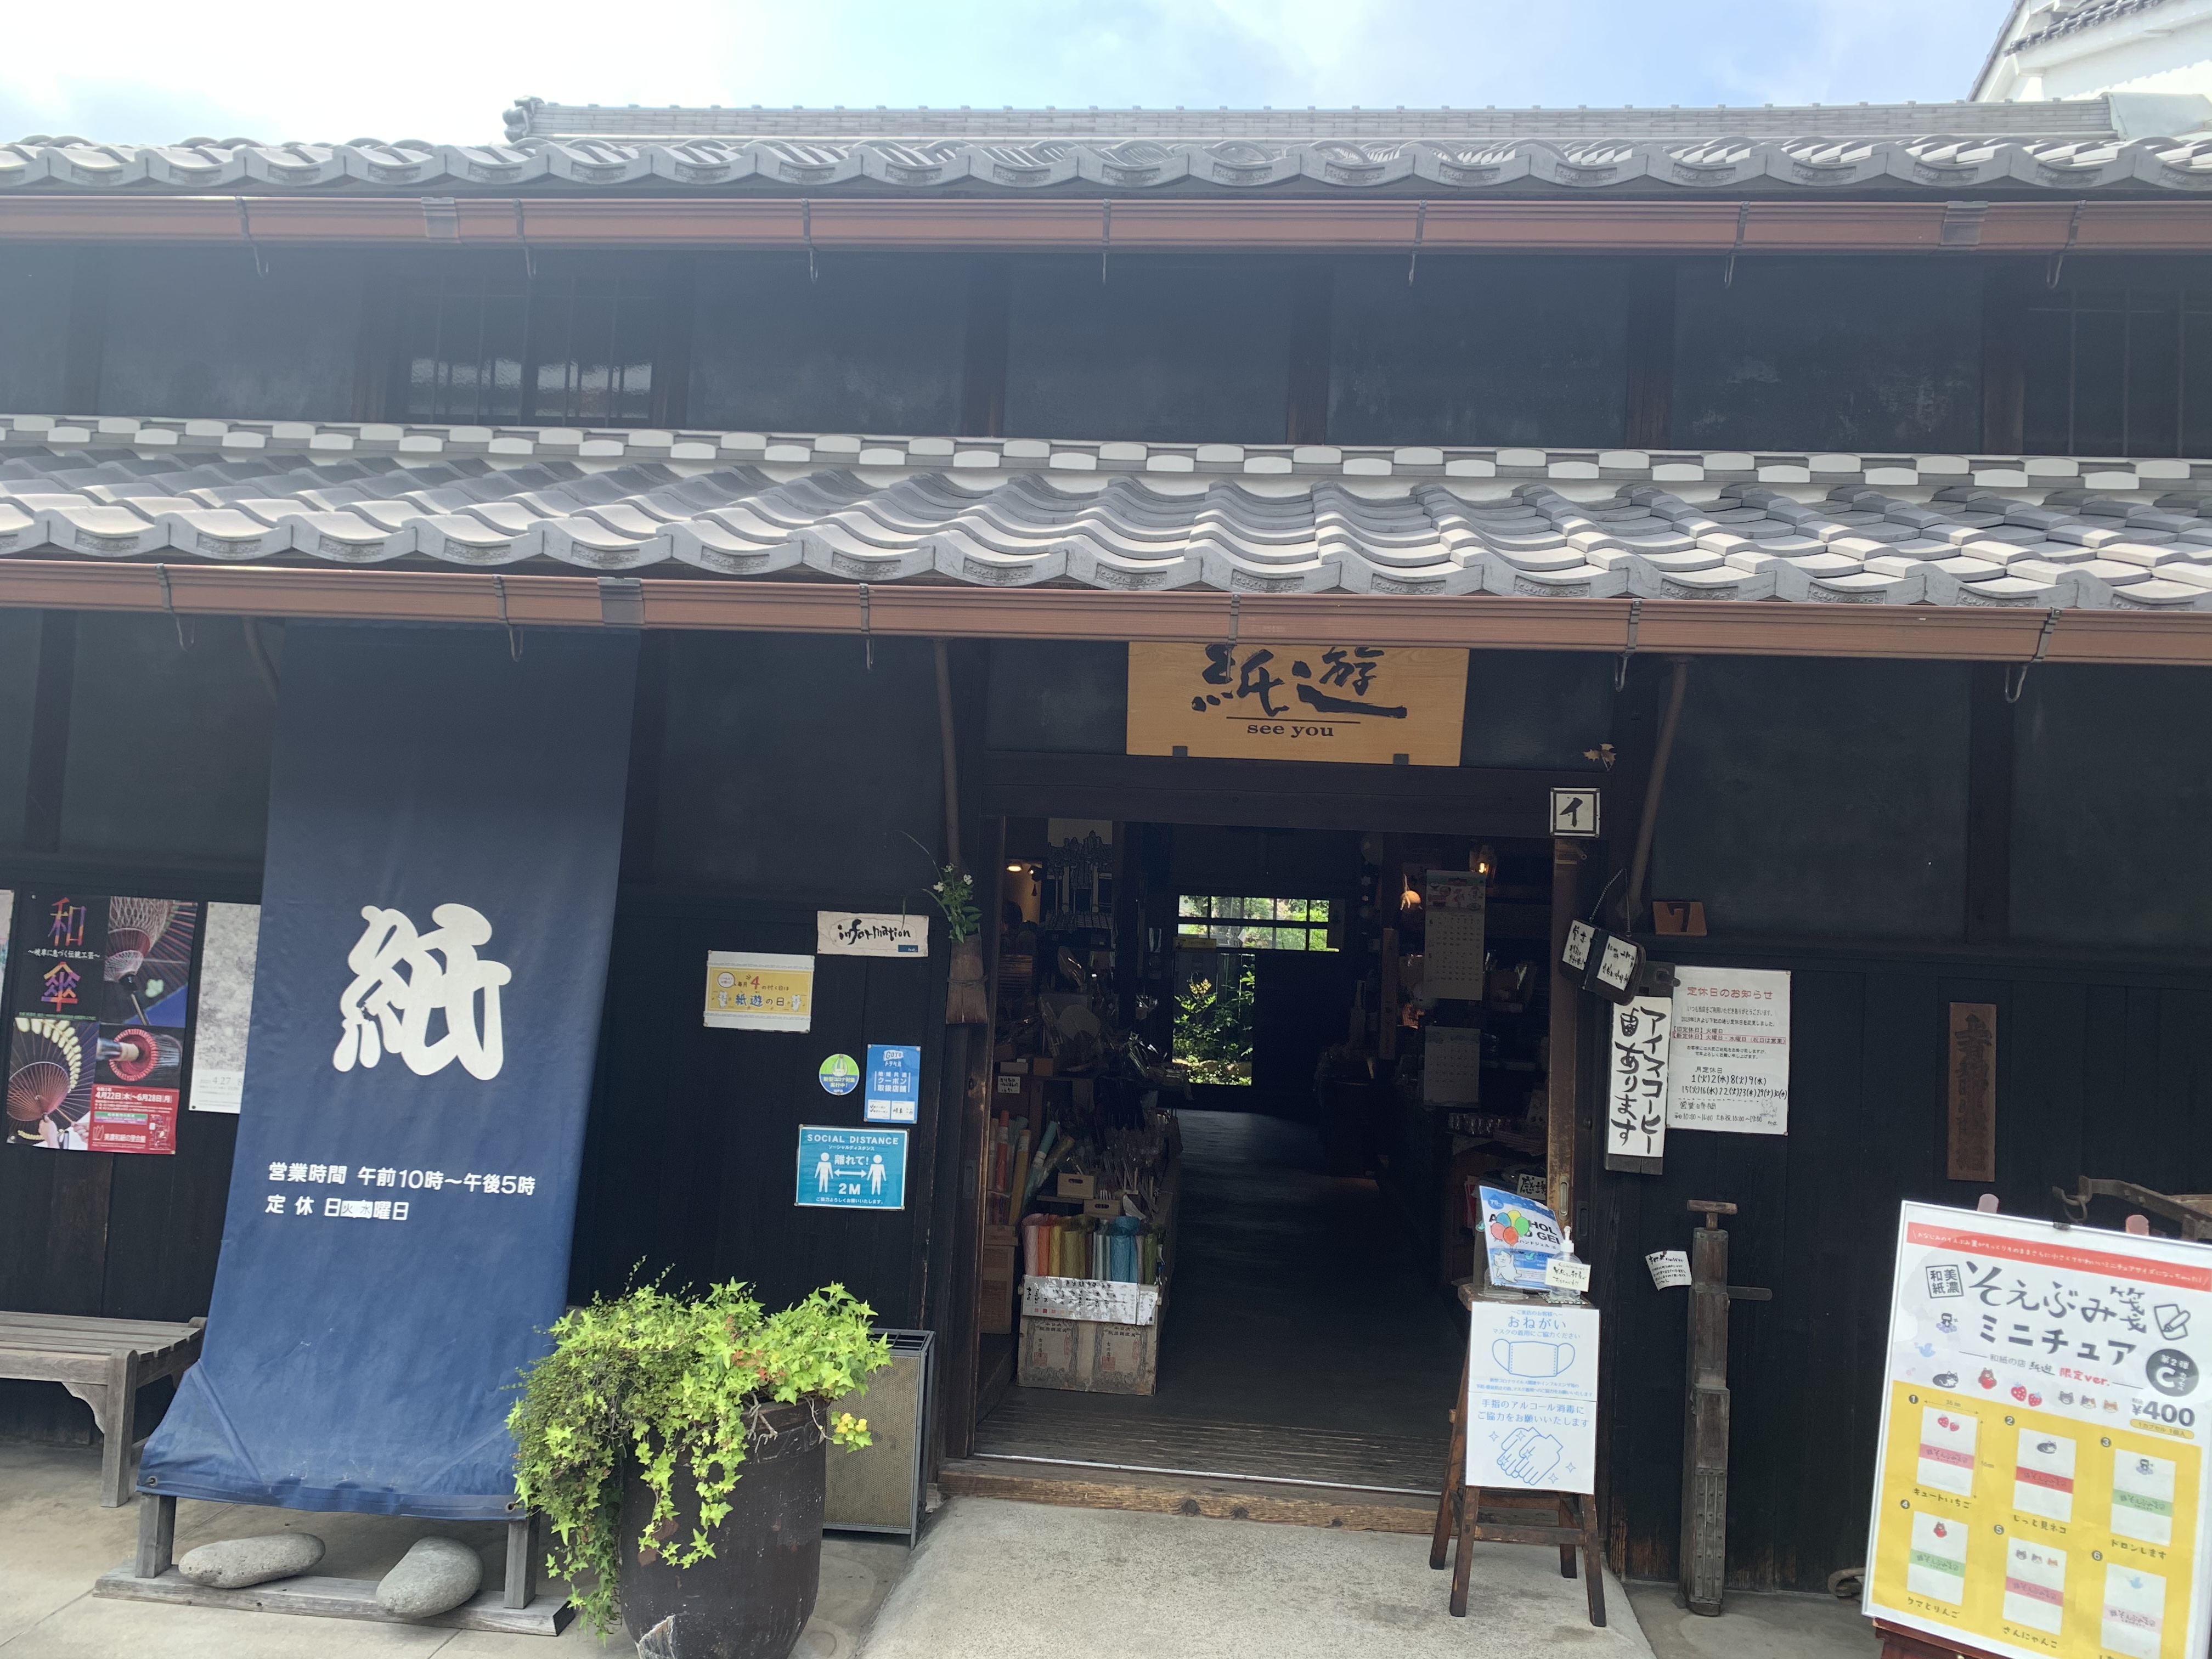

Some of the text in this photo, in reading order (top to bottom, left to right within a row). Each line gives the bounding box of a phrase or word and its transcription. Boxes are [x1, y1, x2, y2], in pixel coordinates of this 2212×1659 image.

[1247, 722, 1334, 738] see you
[1560, 797, 1583, 827] イ
[48, 897, 87, 946] 和
[837, 919, 911, 946] information
[41, 961, 82, 1012] 傘
[333, 903, 512, 1081] 紙
[1687, 986, 1773, 1000] 定休日のお知らせ
[807, 1134, 899, 1145] SOCIAL DISTANCE
[268, 1161, 347, 1184] 営業時間
[1492, 1328, 1581, 1339] マスクの着用にご協力ください
[1508, 1316, 1566, 1330] おねがい
[1979, 1314, 2137, 1366] ミニチュア
[1990, 1353, 2026, 1368] 和紙の店
[2155, 1366, 2176, 1388] C
[1481, 1398, 1585, 1415] 手指のアルコール消毒に
[1477, 1411, 1589, 1427] ご協力をお願いいたします
[1914, 1488, 1972, 1509] キュートいちご
[2003, 1626, 2057, 1649] さんにゃんこ
